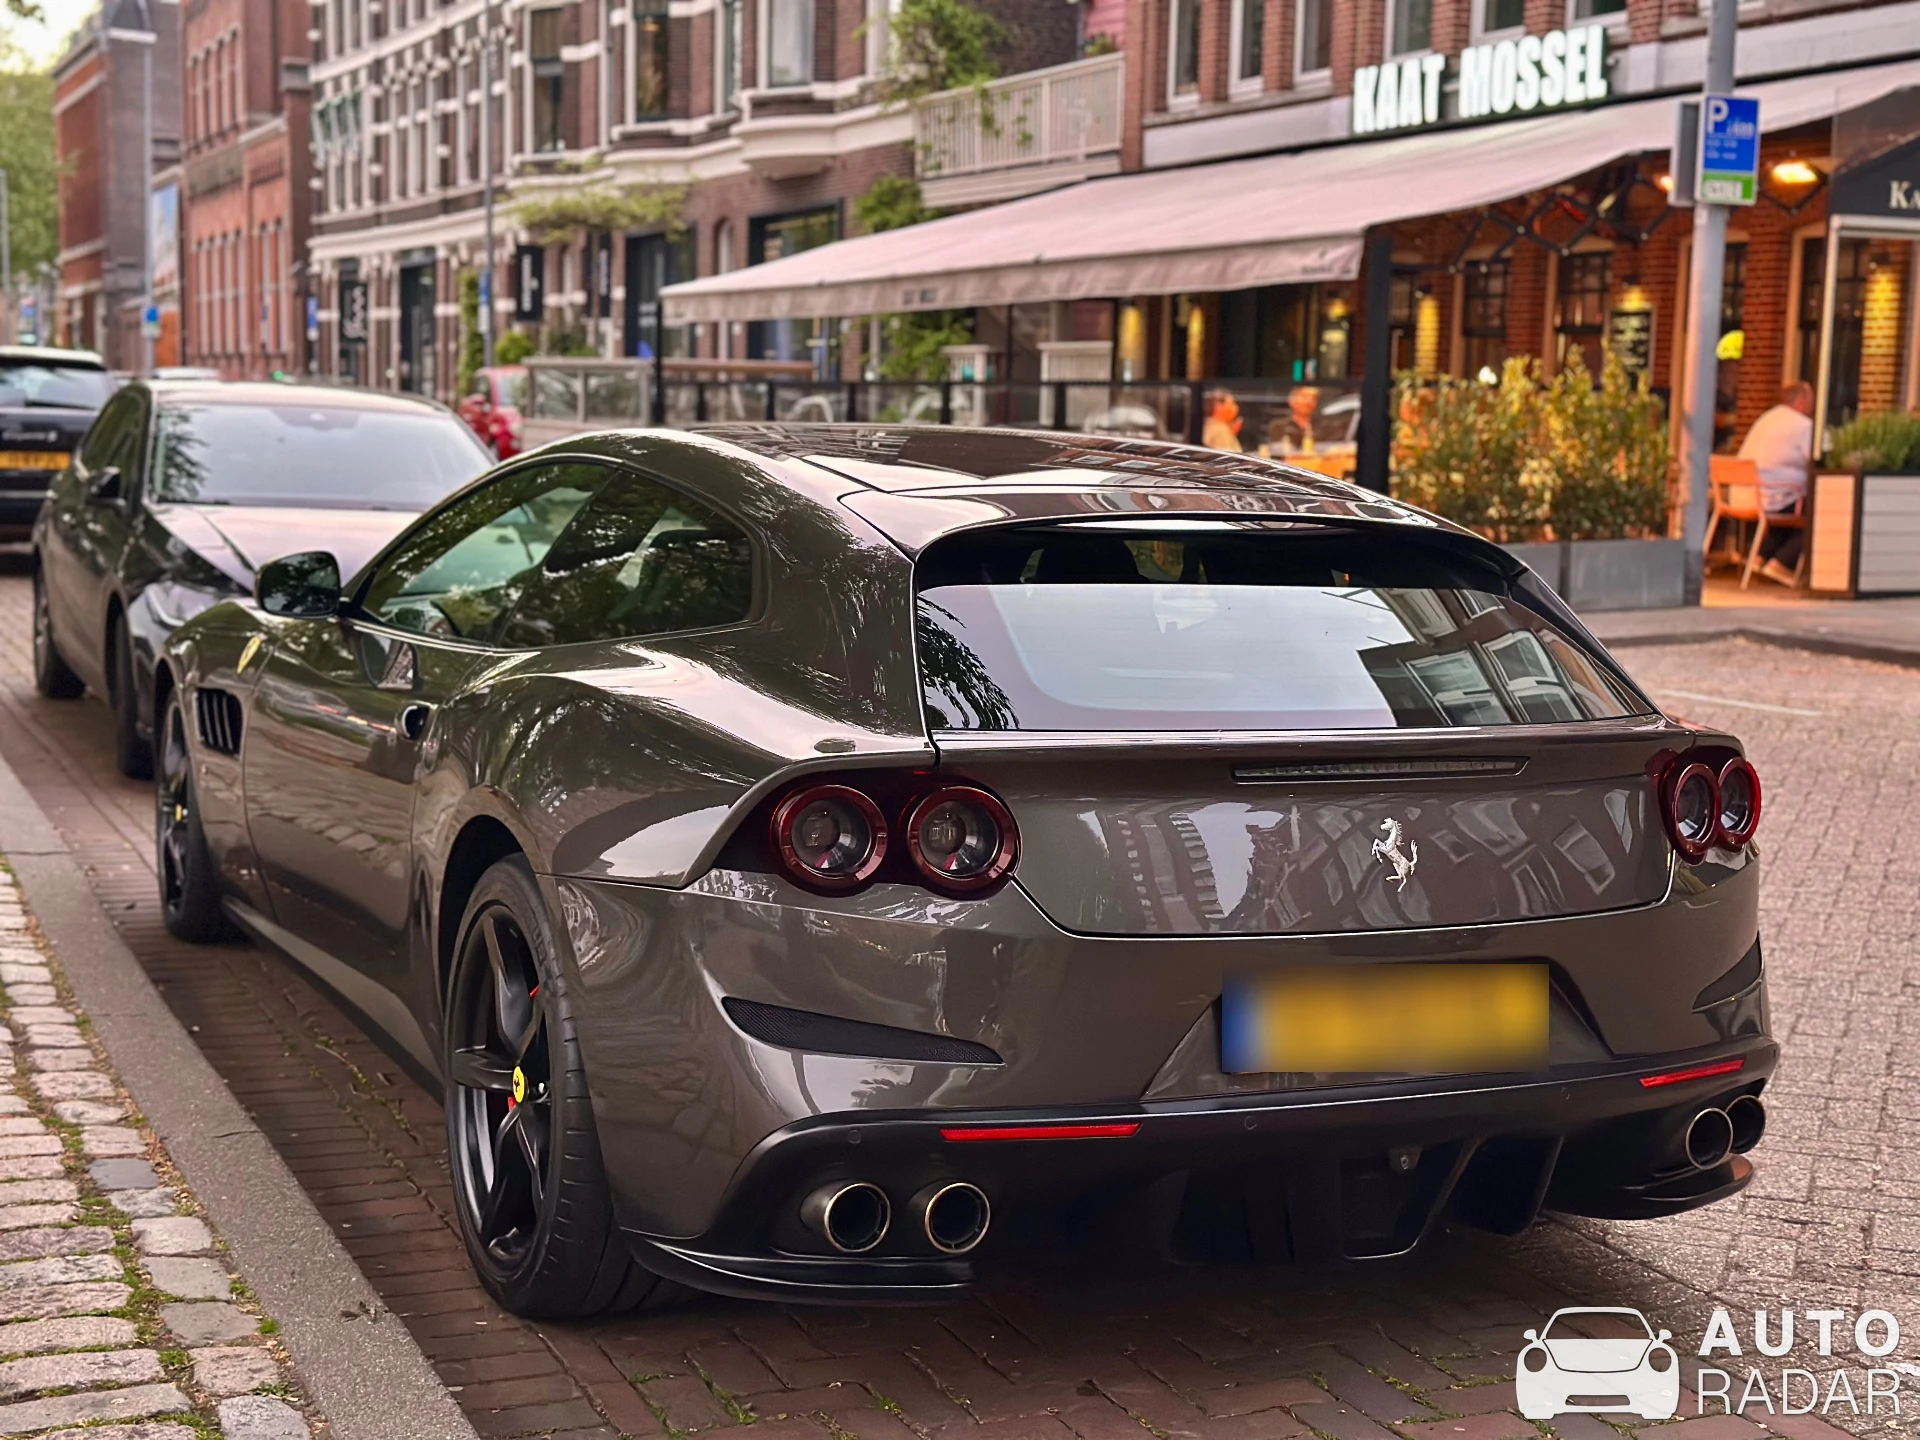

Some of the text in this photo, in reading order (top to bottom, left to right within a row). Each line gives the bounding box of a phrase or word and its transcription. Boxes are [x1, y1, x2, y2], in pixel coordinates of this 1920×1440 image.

[1353, 24, 1608, 133] KAAT MOSSEL
[1706, 99, 1730, 135] P
